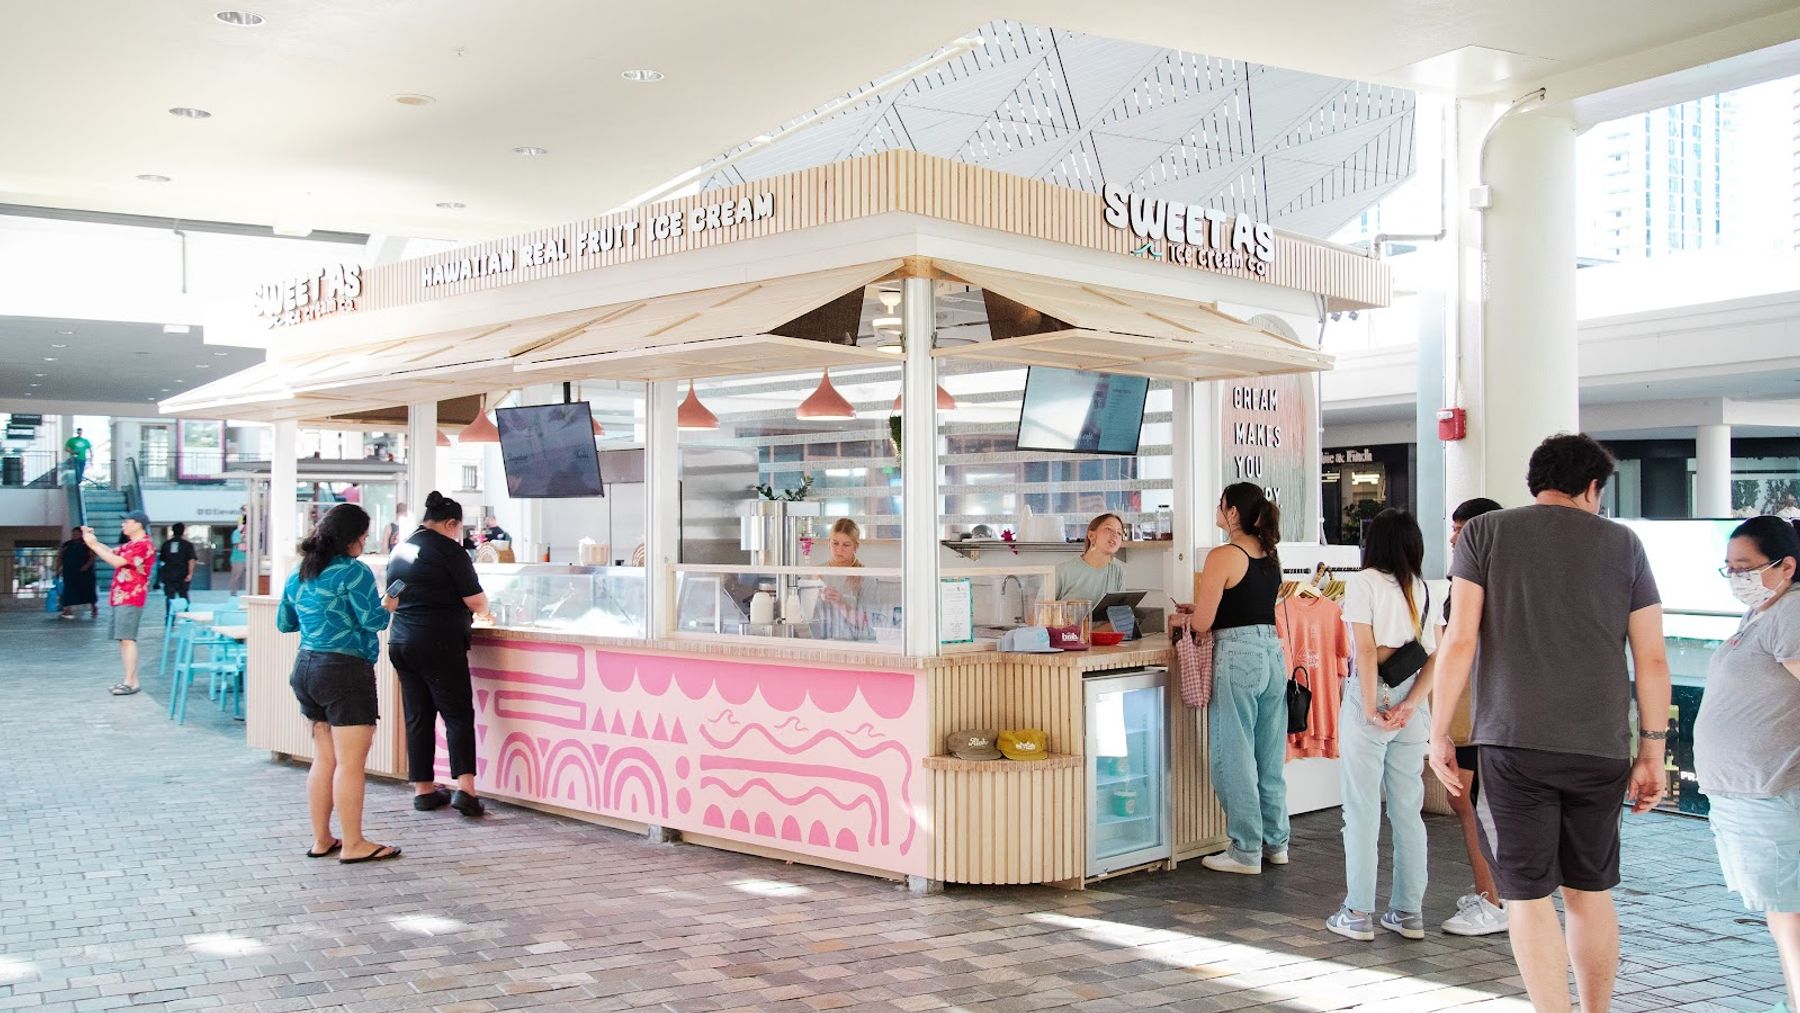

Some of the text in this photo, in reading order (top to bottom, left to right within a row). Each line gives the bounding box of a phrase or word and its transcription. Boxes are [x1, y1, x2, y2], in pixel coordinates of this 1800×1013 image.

[1102, 182, 1275, 263] SWEET AS
[424, 194, 775, 287] HAWAIIAN REAL FRUIT ICE CREAM
[328, 263, 363, 302] AS
[1233, 386, 1278, 411] CREAM
[1234, 422, 1281, 448] MAKES
[1234, 456, 1262, 479] YOU
[1346, 448, 1373, 463] Fitch
